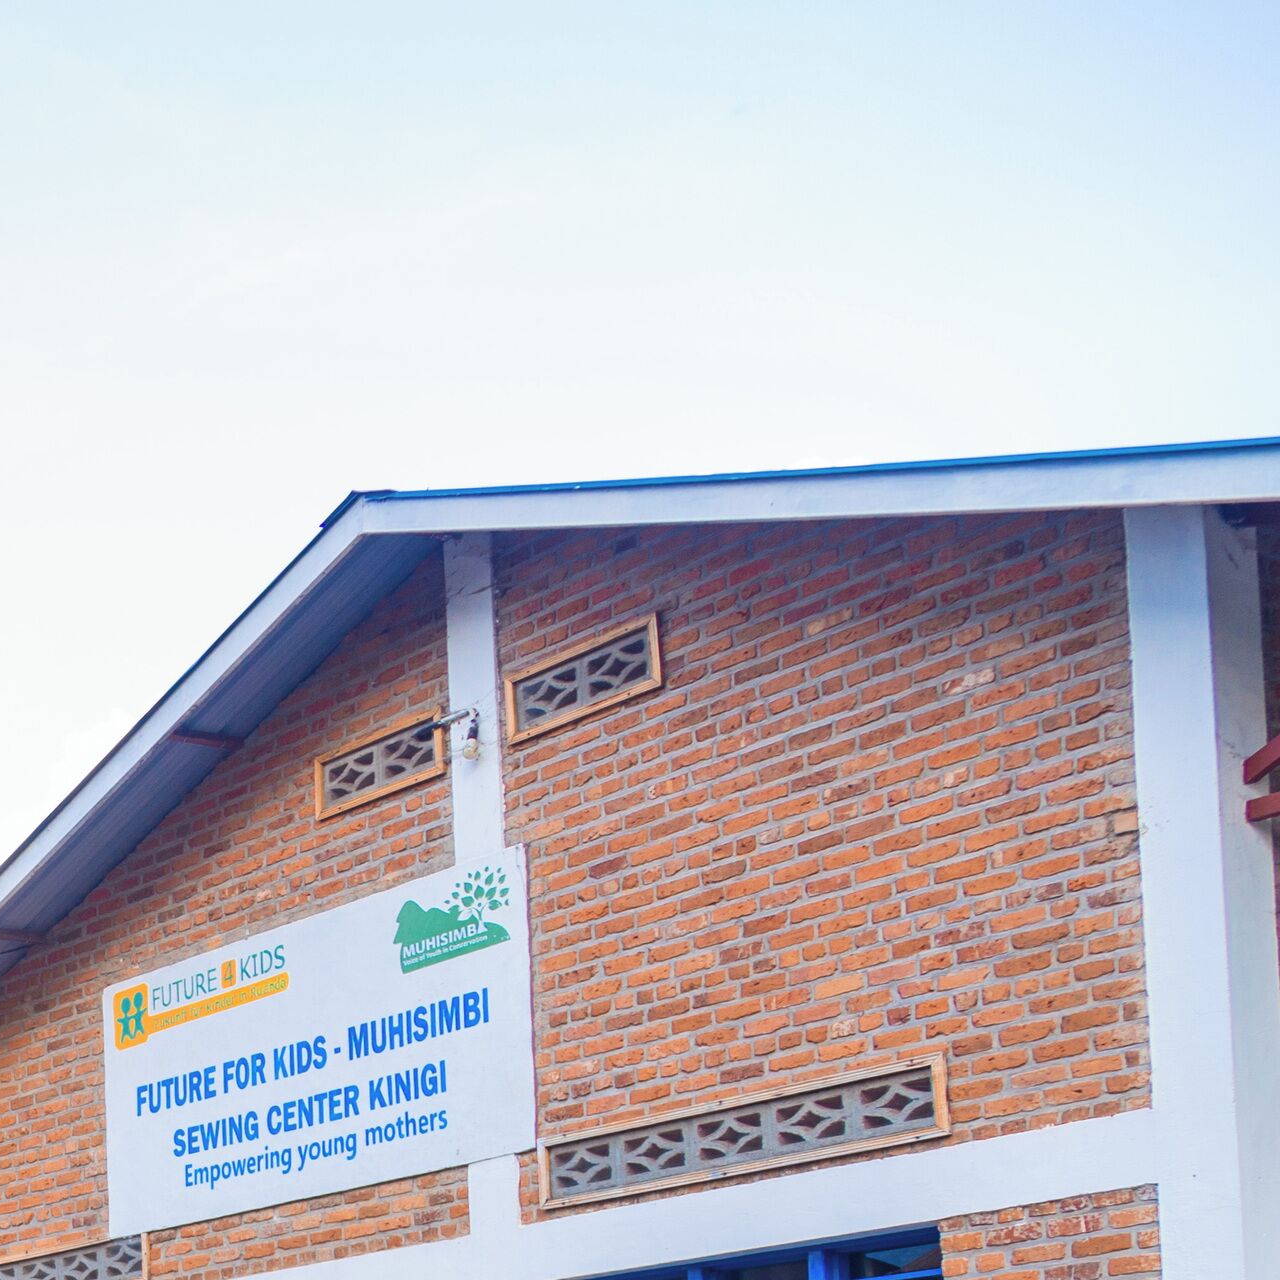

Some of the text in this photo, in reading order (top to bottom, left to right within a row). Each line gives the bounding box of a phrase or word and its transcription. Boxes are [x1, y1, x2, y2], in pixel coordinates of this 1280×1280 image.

[151, 944, 286, 1010] FUTURE 4 KIDS
[136, 1065, 217, 1117] FUTURE
[223, 1052, 266, 1093] FOR
[274, 1035, 327, 1080] KIDS
[348, 987, 489, 1060] MUHISIMBI
[173, 1060, 447, 1157] SEWING CENTER KINIGI
[184, 1110, 448, 1190] Empowering young mothers
